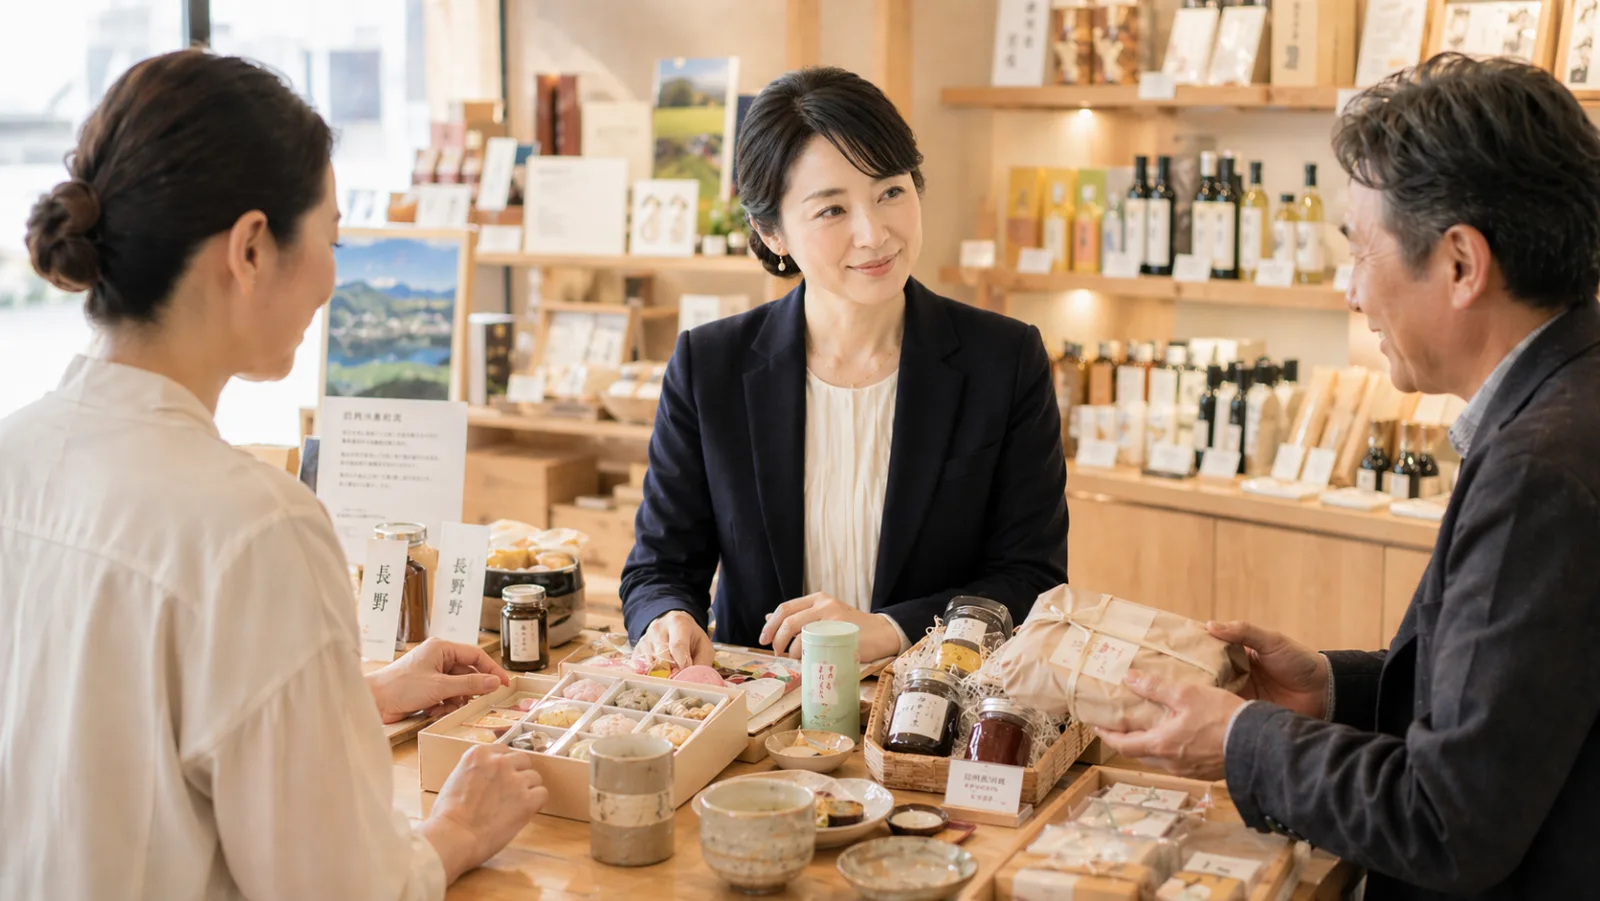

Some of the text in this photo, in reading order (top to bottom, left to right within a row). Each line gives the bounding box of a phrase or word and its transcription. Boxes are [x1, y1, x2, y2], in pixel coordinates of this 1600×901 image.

[372, 564, 391, 612] 長野
[448, 557, 467, 616] 長野野
